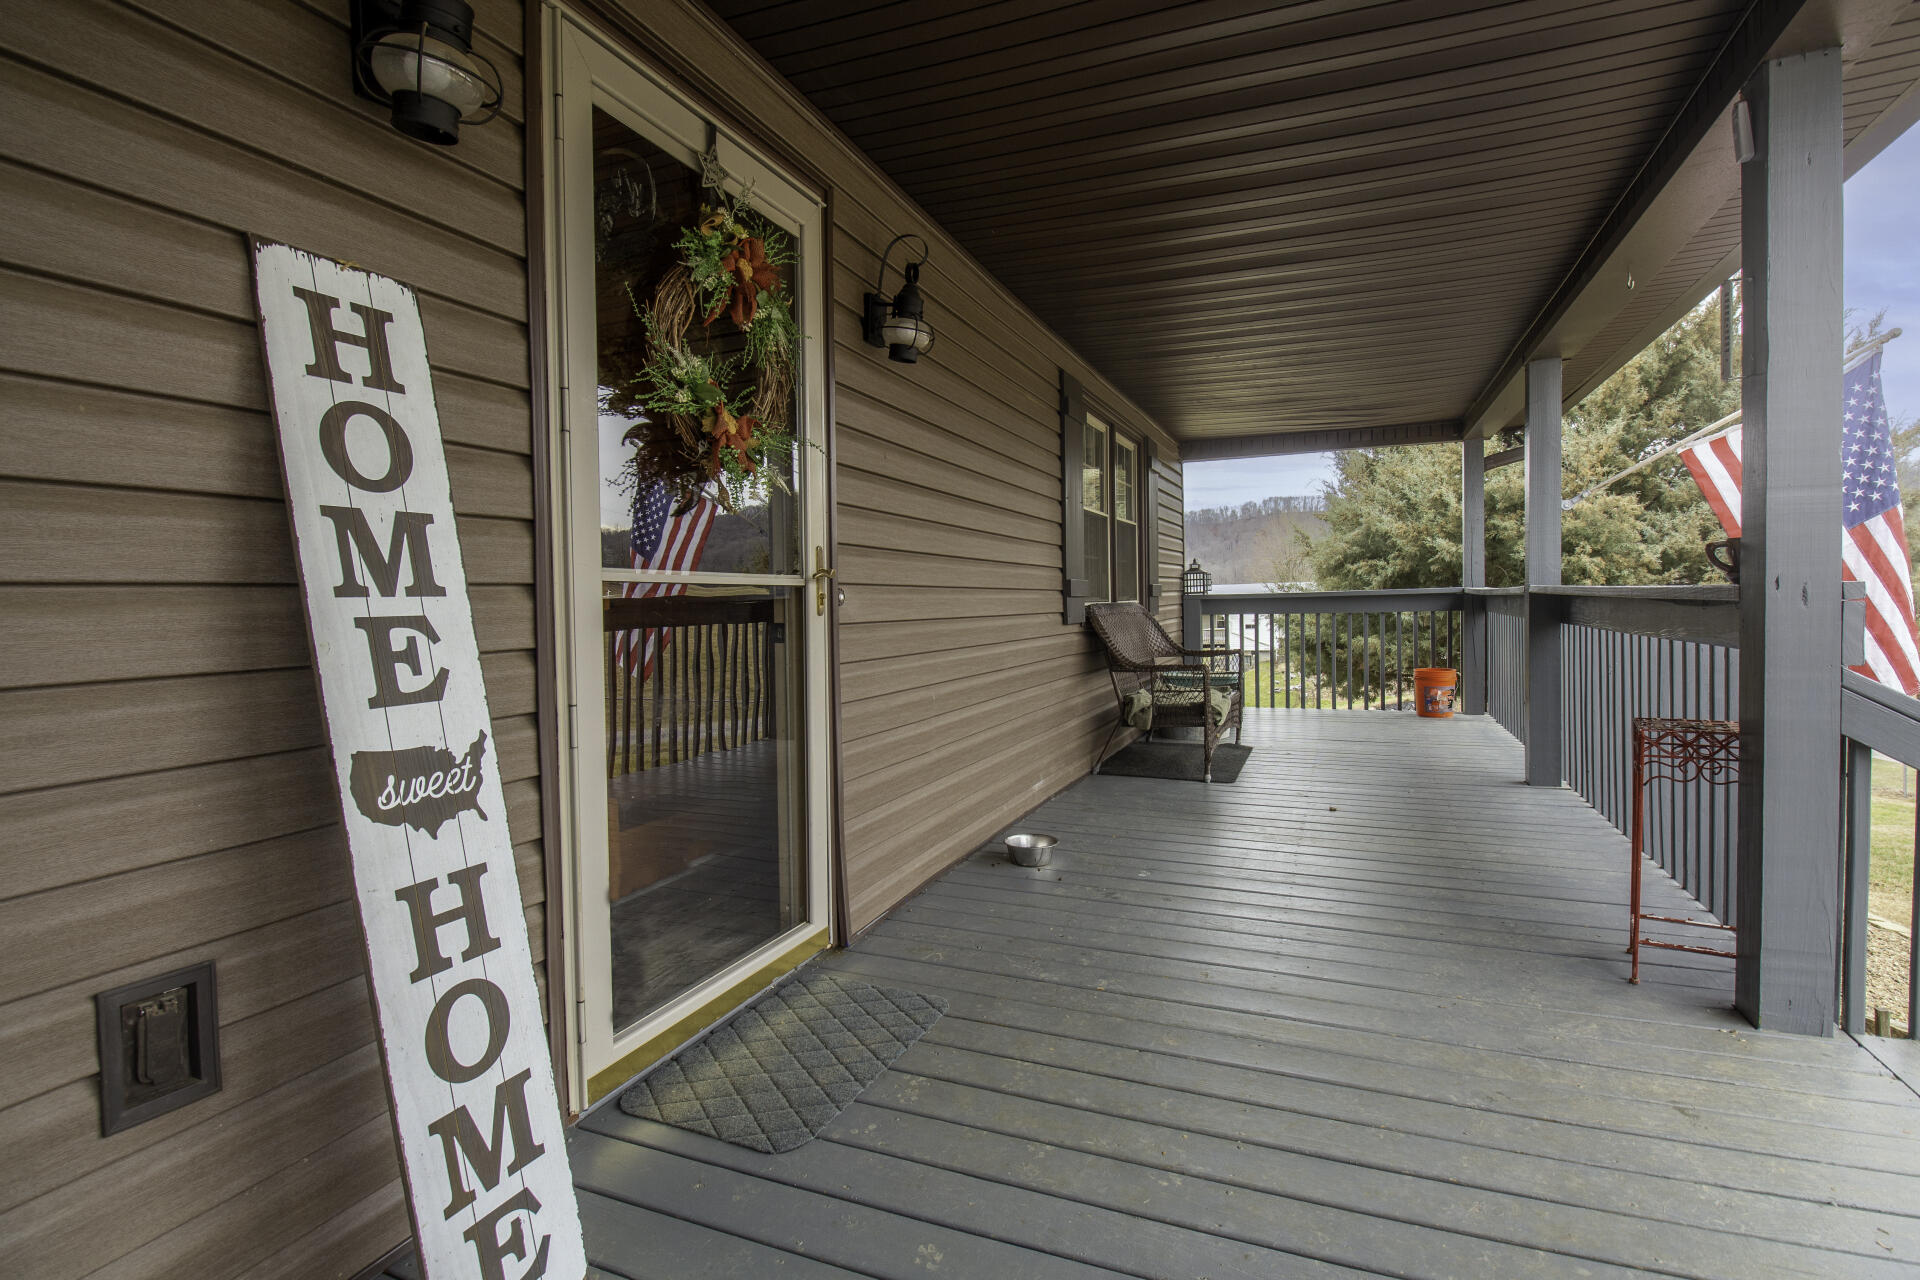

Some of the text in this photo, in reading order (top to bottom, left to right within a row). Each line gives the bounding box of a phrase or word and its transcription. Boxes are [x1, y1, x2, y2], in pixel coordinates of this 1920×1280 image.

[292, 285, 450, 709] HOME
[378, 756, 476, 810] sweet
[395, 862, 551, 1280] HOME
